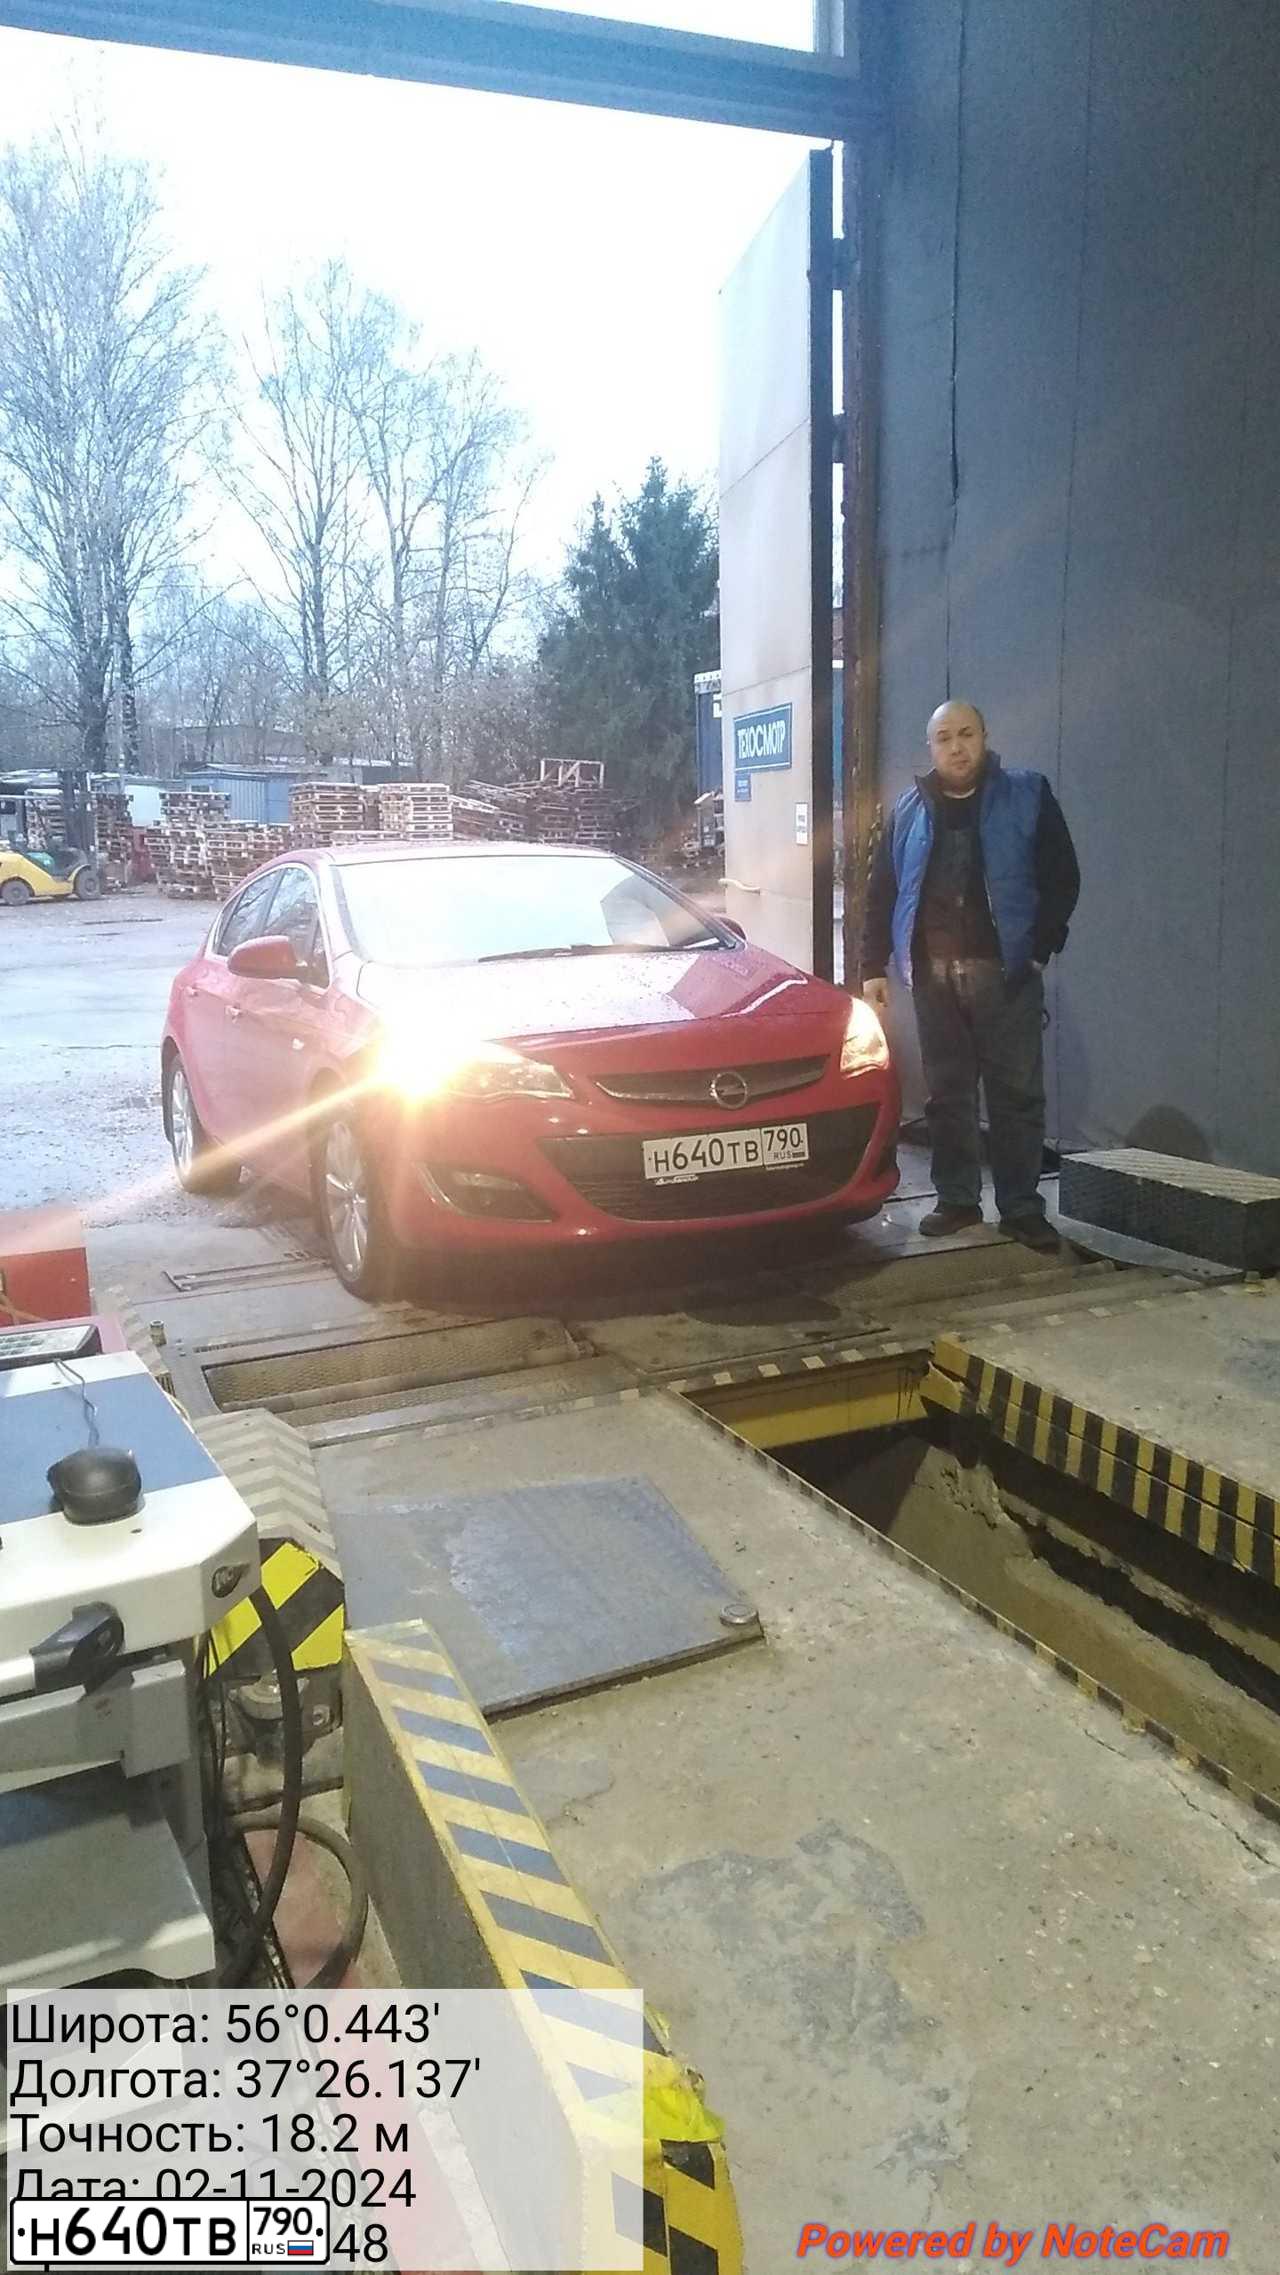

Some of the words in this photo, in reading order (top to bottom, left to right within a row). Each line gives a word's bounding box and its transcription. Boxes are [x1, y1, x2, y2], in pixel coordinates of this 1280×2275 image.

[737, 720, 786, 759] ТЕХОСМОТР
[653, 1137, 759, 1173] Н640ТВ
[763, 1127, 801, 1152] 790
[773, 1150, 792, 1161] RUS
